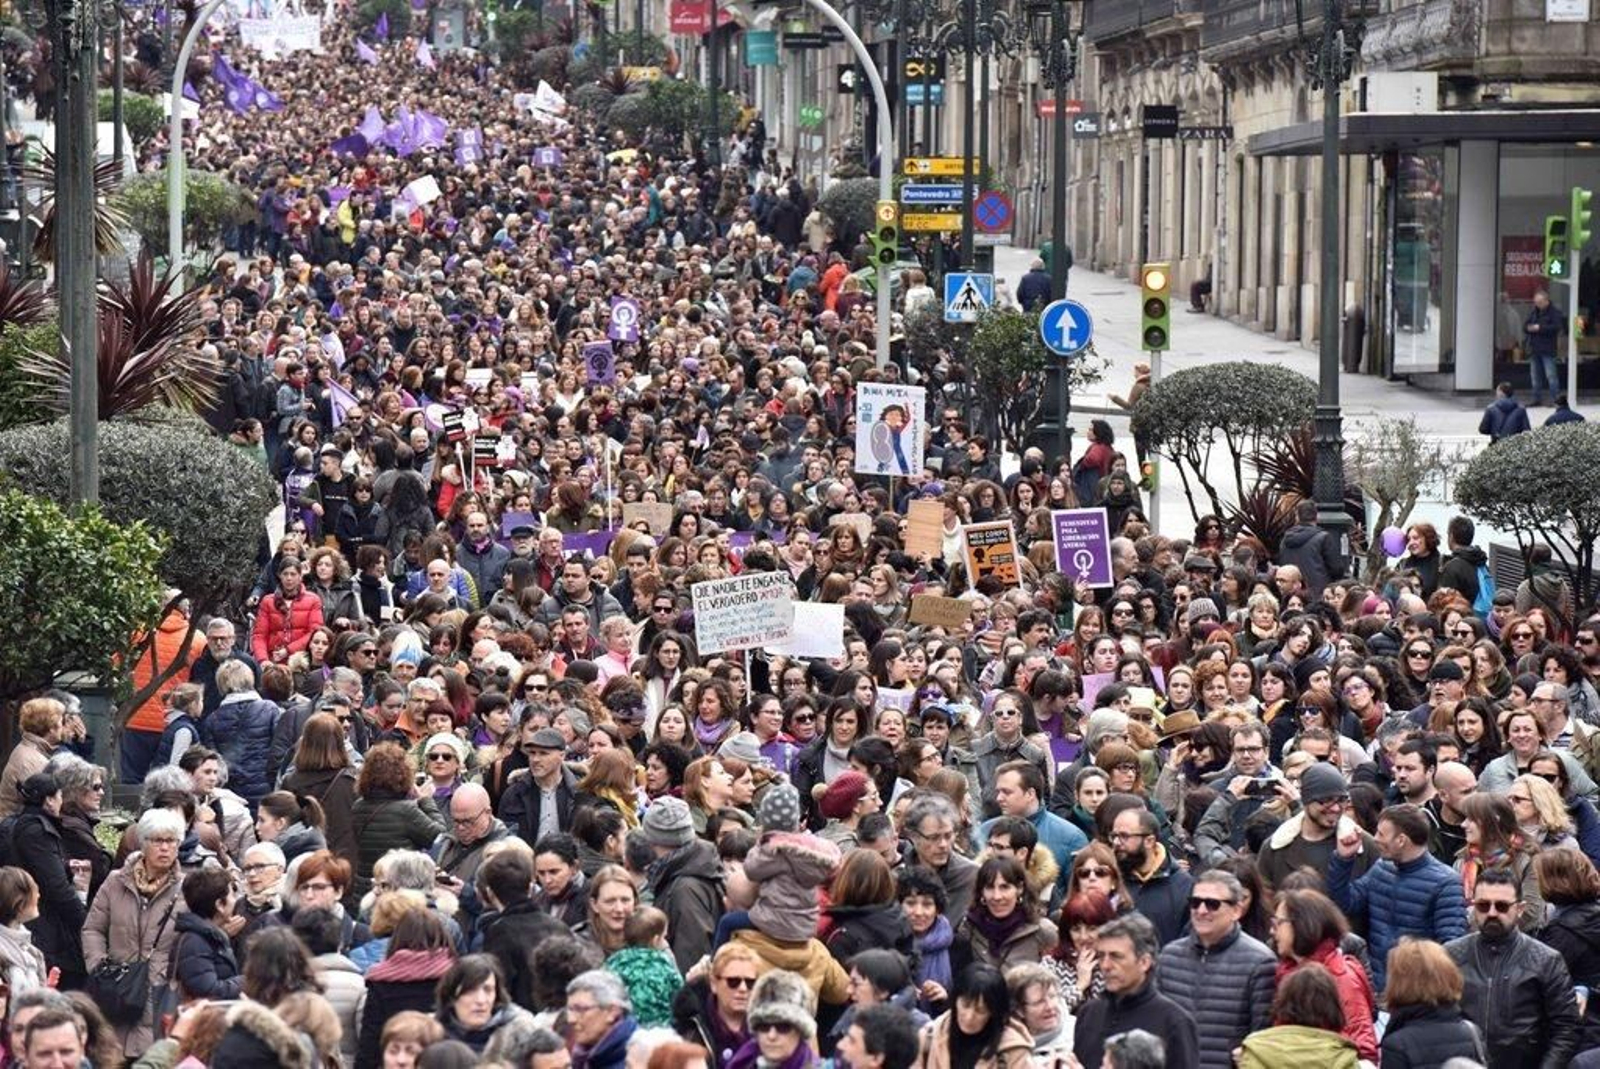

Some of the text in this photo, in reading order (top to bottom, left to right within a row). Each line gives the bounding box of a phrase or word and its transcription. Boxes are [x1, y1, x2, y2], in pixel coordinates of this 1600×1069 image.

[1182, 130, 1227, 138] ZARA
[905, 190, 950, 198] Pontevedra
[1504, 263, 1546, 275] REBAJAS
[694, 572, 789, 598] QUE NADIE TE ENGAÑE
[698, 600, 709, 611] EL
[710, 592, 758, 610] VERDADERO
